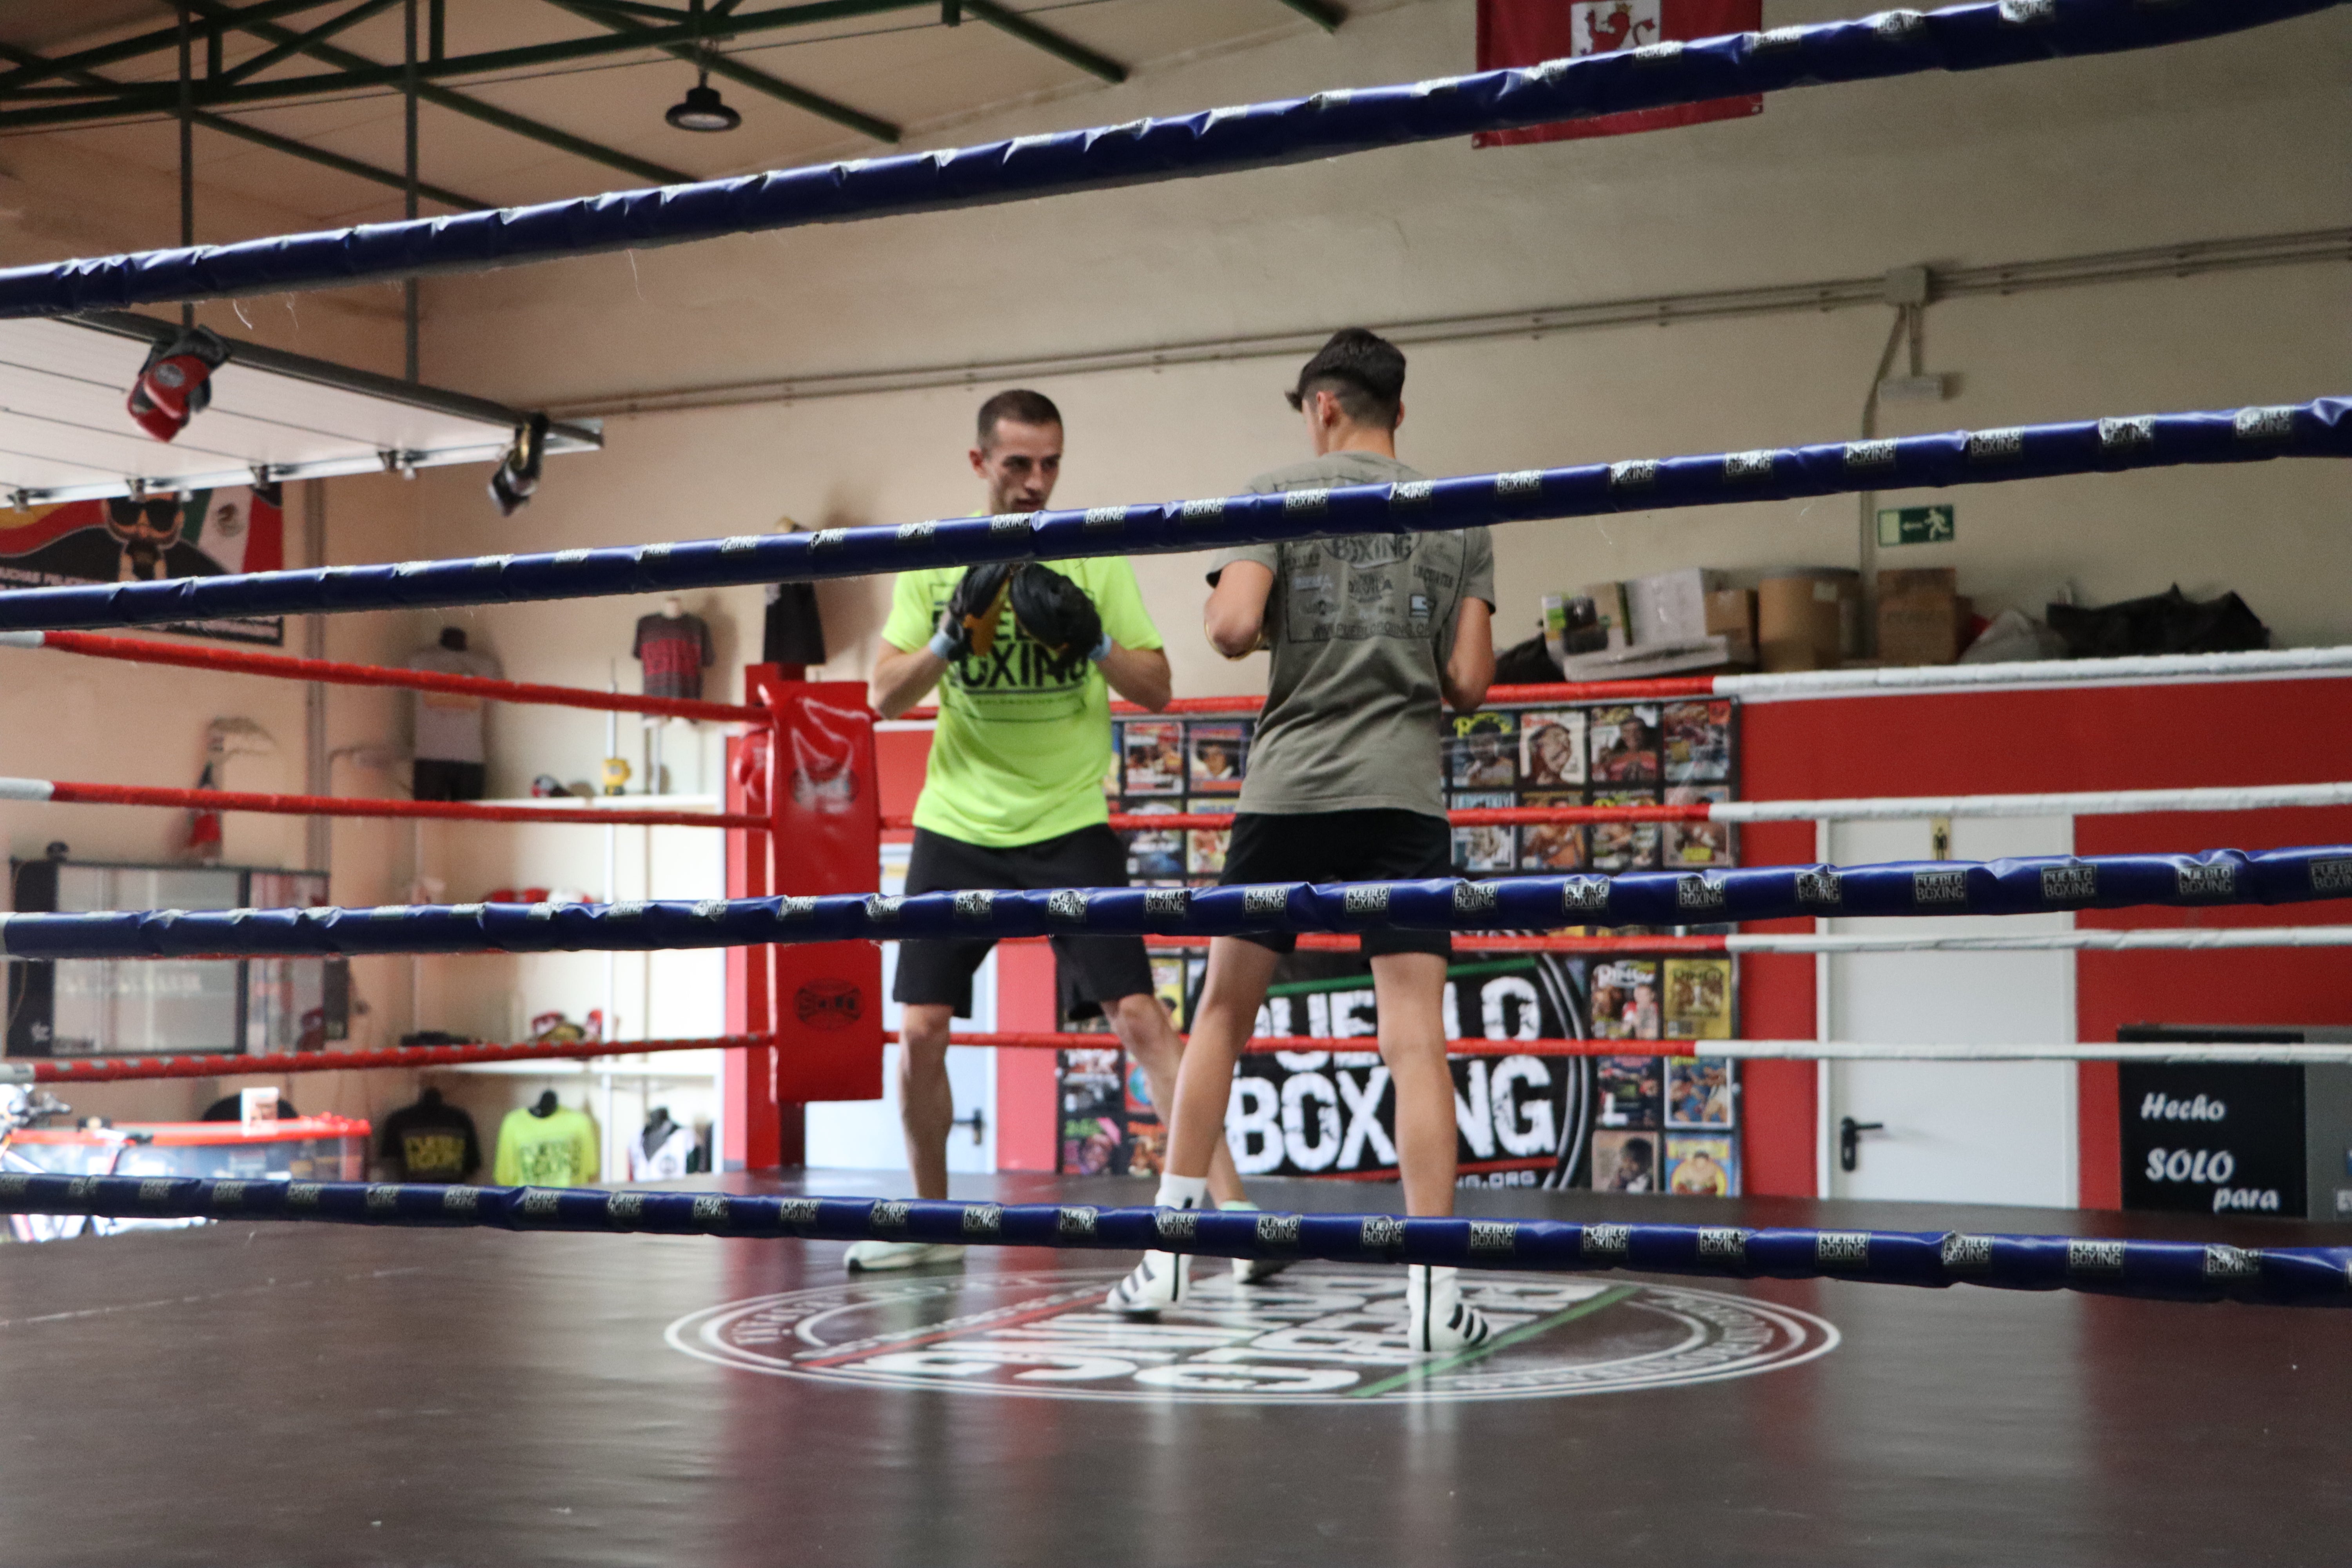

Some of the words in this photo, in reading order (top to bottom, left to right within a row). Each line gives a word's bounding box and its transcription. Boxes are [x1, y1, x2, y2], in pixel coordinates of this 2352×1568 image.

[1971, 436, 2021, 456] BOXING
[1497, 476, 1540, 492] BOXING
[1285, 494, 1326, 509] BOXING
[1183, 503, 1223, 516] BOXING
[1086, 511, 1124, 524] BOXING
[1915, 875, 1962, 888] PUEBLO
[2043, 870, 2092, 884] PUEBLO
[1245, 888, 1286, 899] PUEBLO
[1347, 887, 1388, 899] PUEBLO
[1916, 884, 1964, 900] BOXING
[2044, 880, 2094, 898] BOXING
[2179, 879, 2232, 894] BOXING
[956, 898, 991, 911] BOXING
[1146, 898, 1184, 912] BOXING
[1245, 897, 1285, 911] BOXING
[1346, 895, 1387, 910] BOXING
[1455, 893, 1495, 908] BOXING
[1566, 893, 1606, 907] BOXING
[1679, 890, 1722, 905] BOXING
[1049, 901, 1085, 914] BOXING
[2141, 1092, 2226, 1121] Hecho
[1227, 1056, 1557, 1175] BOXNG
[2145, 1147, 2235, 1184] SOLO
[2213, 1187, 2281, 1214] para
[964, 1216, 999, 1229] BOXING
[1060, 1217, 1095, 1230] BOXING
[1258, 1226, 1296, 1239] BOXING
[1471, 1231, 1513, 1247] BOXING
[1583, 1235, 1626, 1250] BOXING
[1700, 1237, 1743, 1252] BOXING
[1819, 1241, 1866, 1257] BOXING
[1944, 1247, 1989, 1263] BOXING
[2070, 1250, 2121, 1266] BOXING
